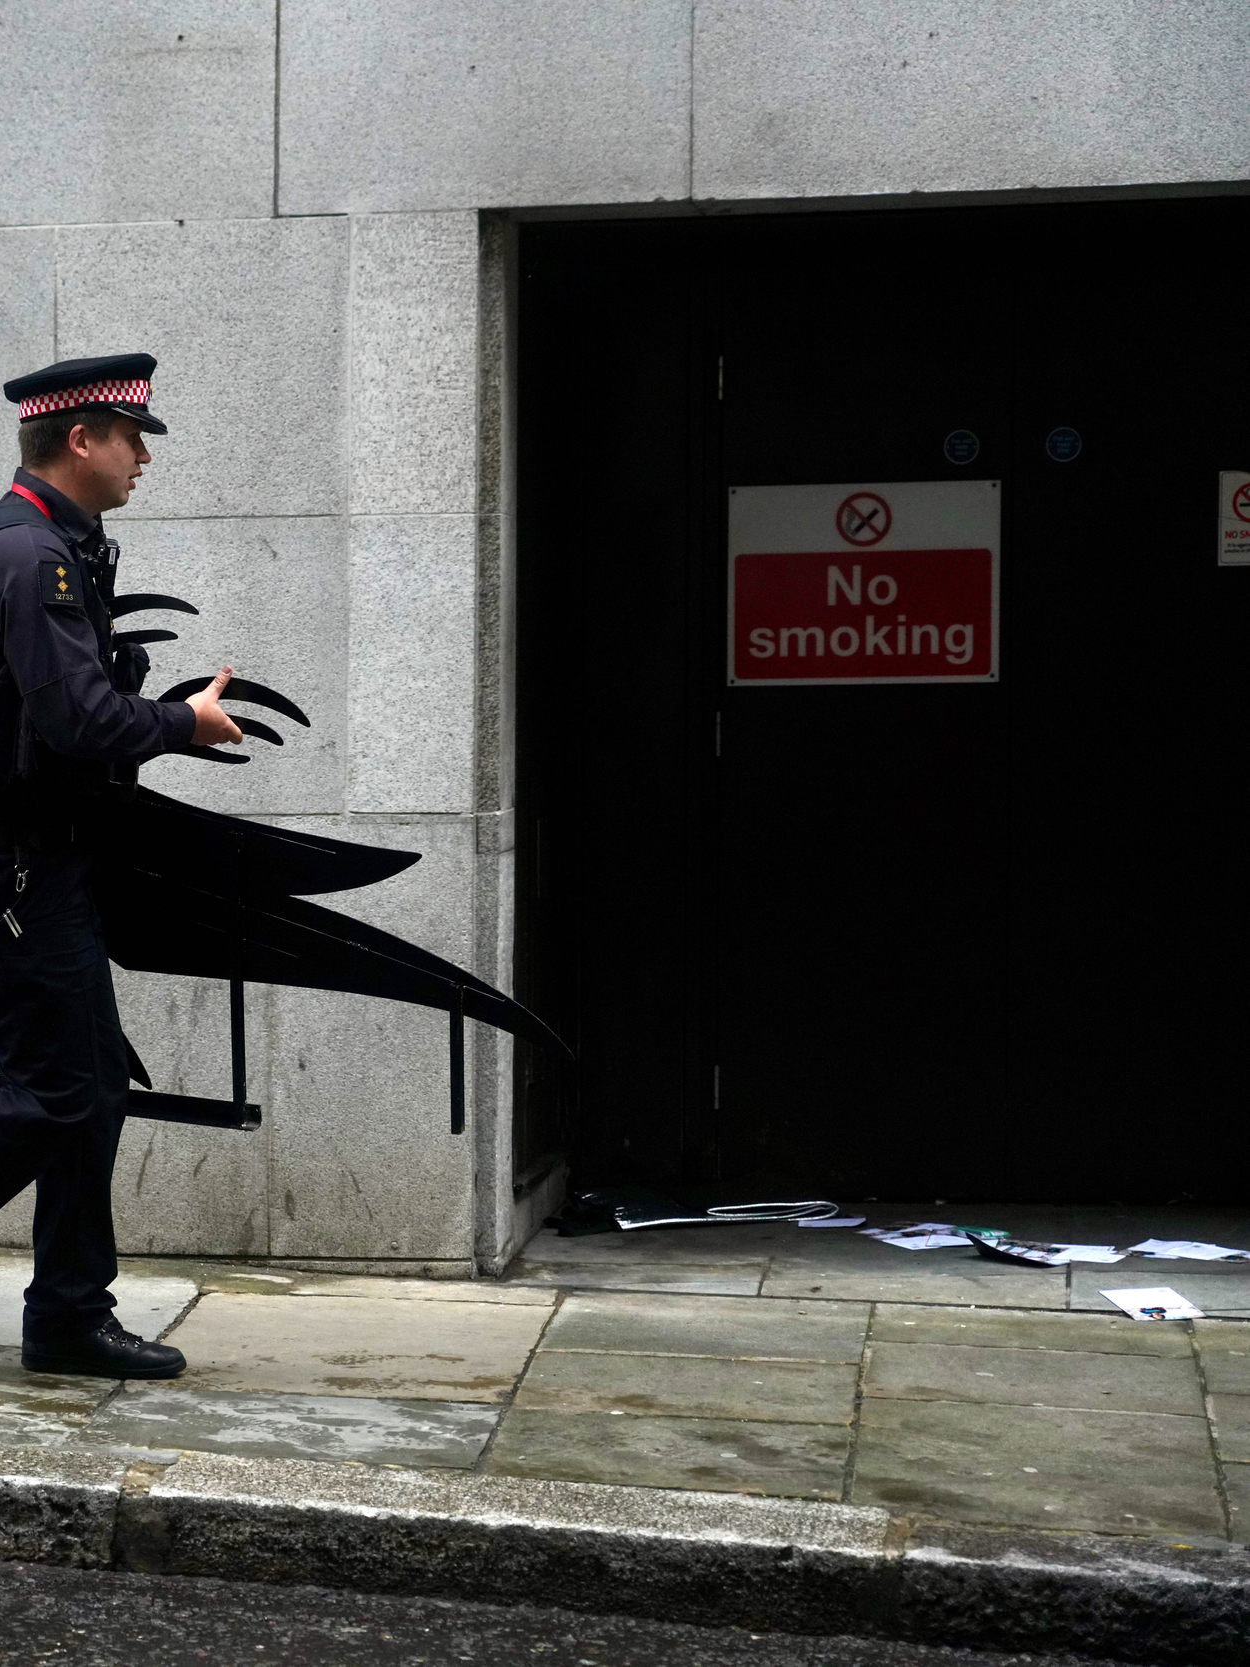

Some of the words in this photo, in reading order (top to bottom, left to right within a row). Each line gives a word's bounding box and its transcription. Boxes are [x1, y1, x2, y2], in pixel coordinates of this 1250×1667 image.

[1224, 530, 1238, 539] NO
[827, 564, 898, 606] No
[748, 614, 974, 665] smoking
